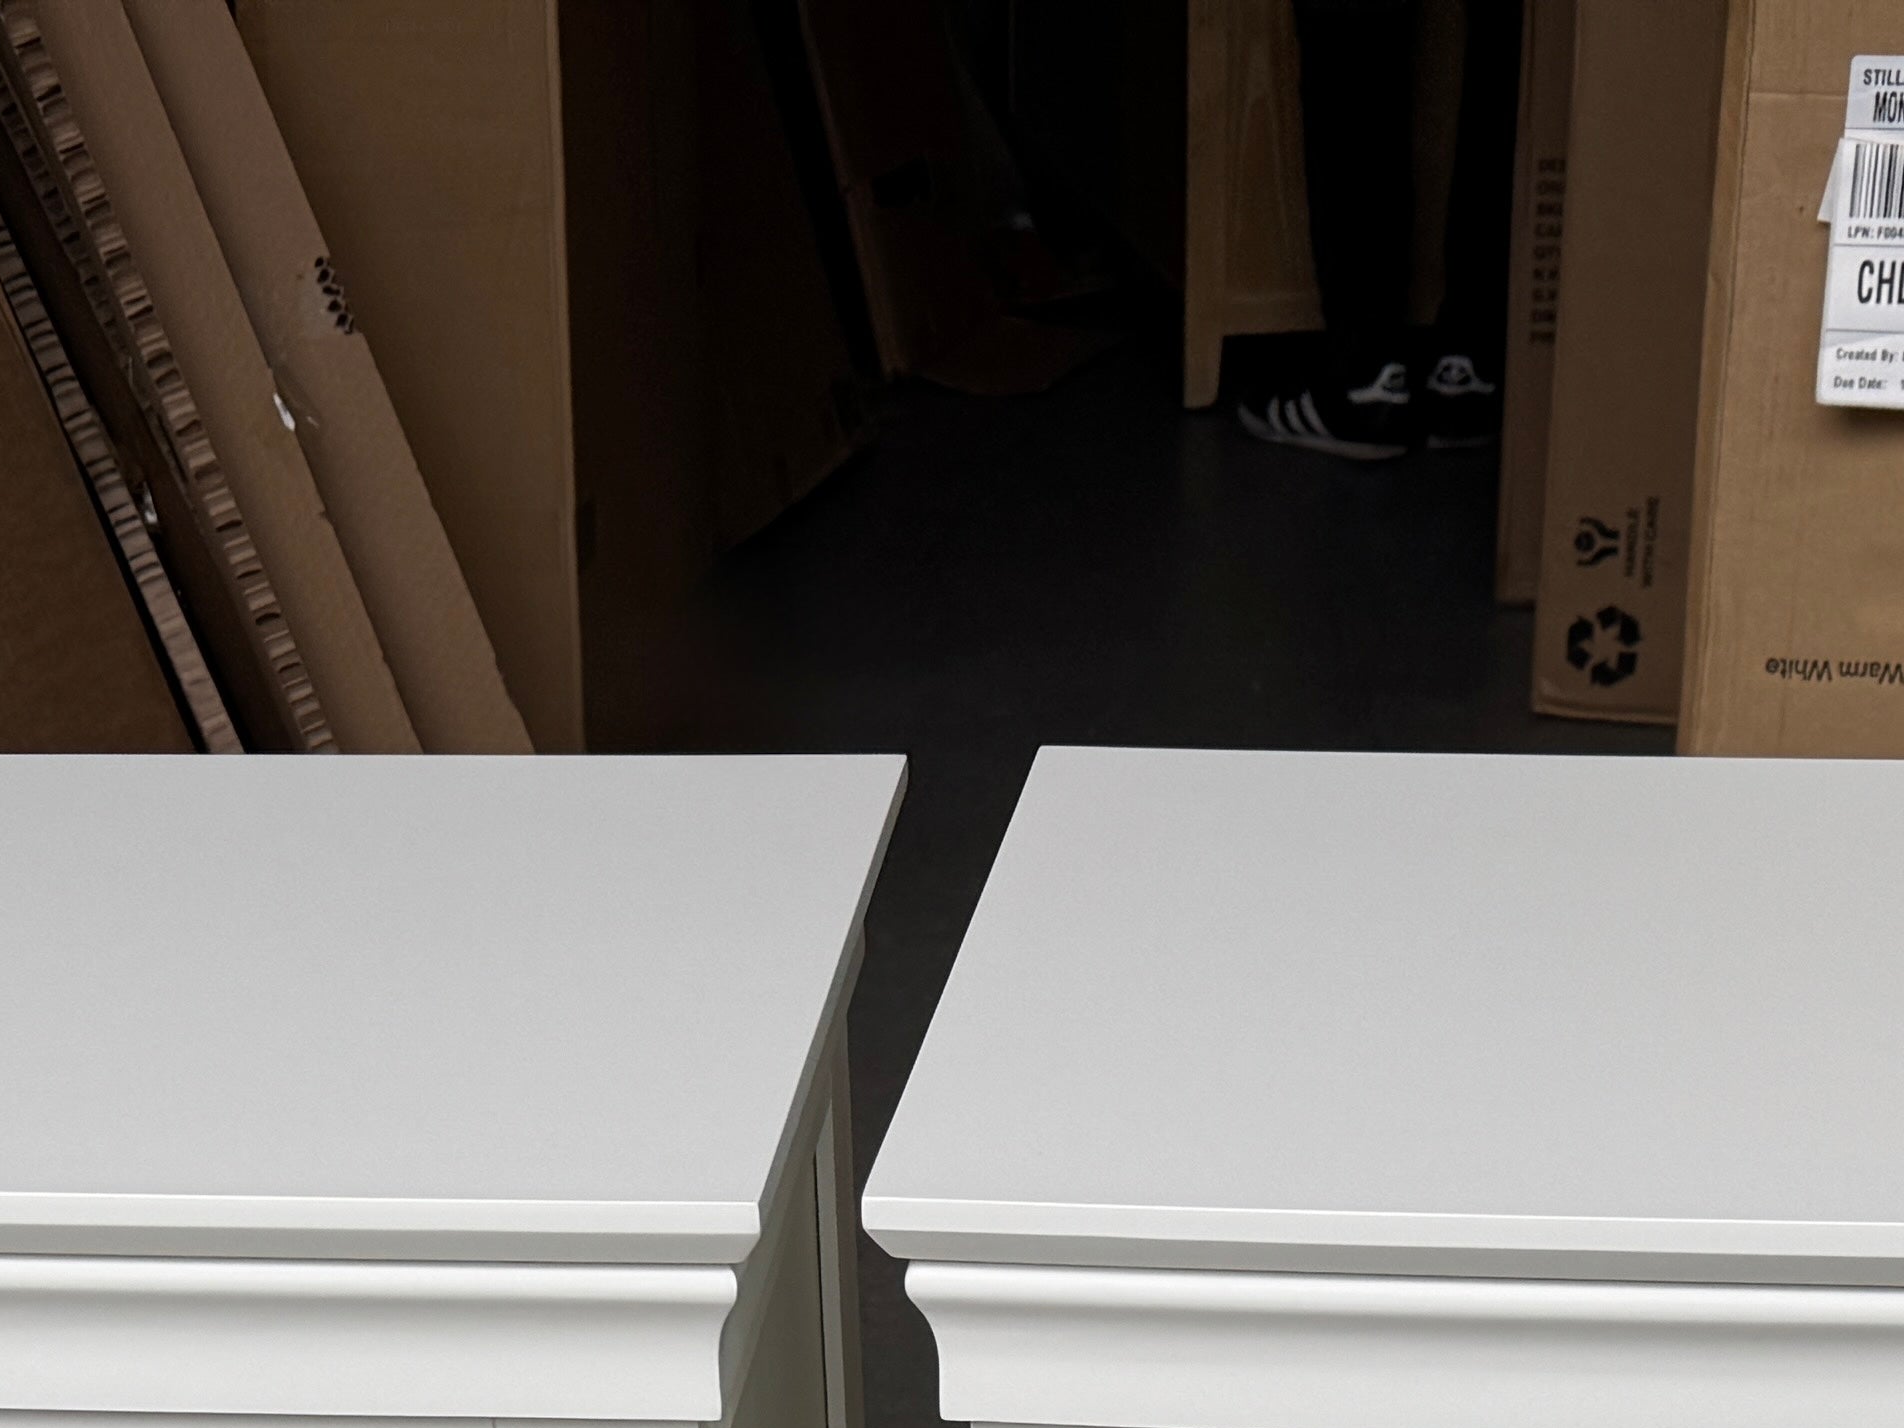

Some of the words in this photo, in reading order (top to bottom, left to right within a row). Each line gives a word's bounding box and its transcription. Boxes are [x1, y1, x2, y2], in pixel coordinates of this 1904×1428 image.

[1835, 347, 1877, 361] Created
[1880, 348, 1898, 363] By:
[1833, 375, 1855, 389] Due
[1857, 376, 1886, 389] Date:
[1765, 657, 1833, 682] White
[1837, 660, 1904, 685] Warm
